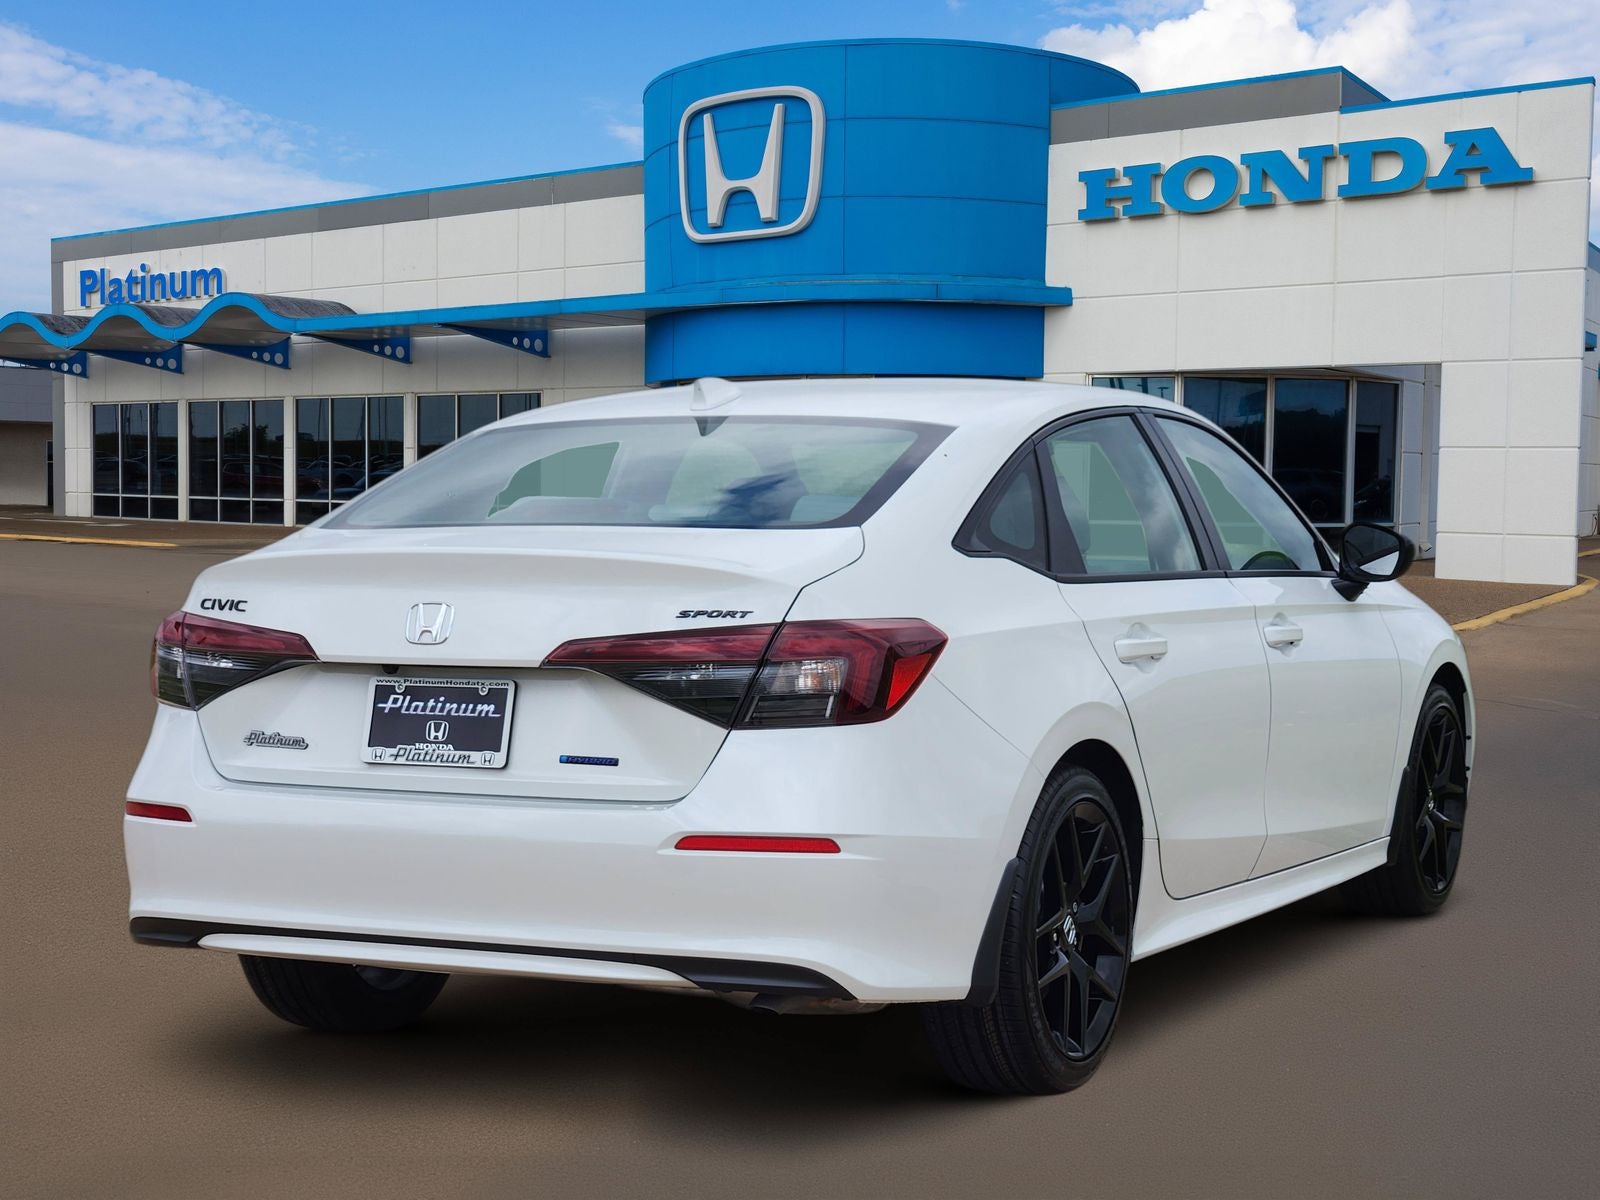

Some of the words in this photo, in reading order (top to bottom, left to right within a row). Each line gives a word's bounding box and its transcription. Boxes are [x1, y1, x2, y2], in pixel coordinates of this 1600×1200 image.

[1078, 126, 1533, 221] HONDA
[79, 263, 225, 307] Platinum
[200, 598, 248, 612] CIVIC
[675, 610, 754, 619] SPORT
[376, 678, 510, 688] www.PlatinumHondatx.com
[377, 694, 501, 717] Platinum
[243, 730, 309, 750] Platinum
[415, 742, 454, 751] HONDA
[389, 745, 476, 765] Platinum
